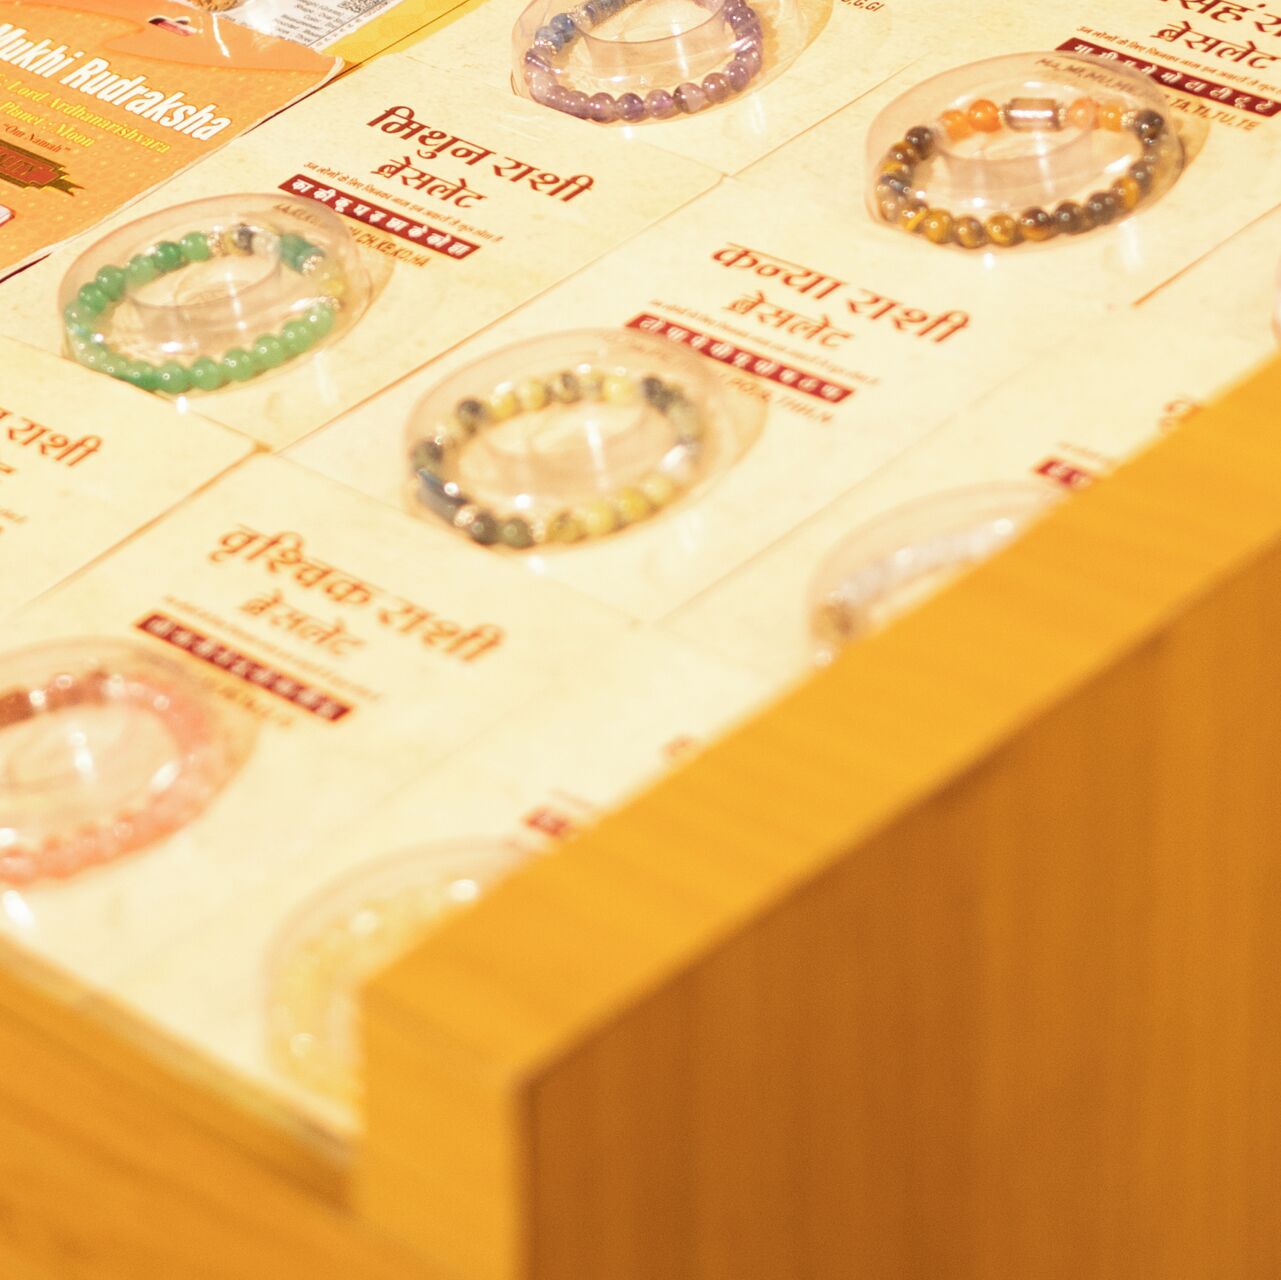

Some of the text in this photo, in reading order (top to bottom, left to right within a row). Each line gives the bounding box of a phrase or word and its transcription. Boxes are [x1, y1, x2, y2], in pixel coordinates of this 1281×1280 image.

[1150, 20, 1281, 70] ब्रेसलेट
[7, 80, 50, 103] Lord
[48, 95, 172, 155] Ardhanarishvara
[64, 57, 233, 141] Rudraksha
[54, 124, 95, 148] Moon
[366, 105, 496, 166] मिथुन
[492, 156, 595, 202] राशी
[370, 155, 488, 209] ब्रेसलेट
[711, 242, 847, 300] कन्या
[846, 288, 970, 343] राशी
[723, 290, 854, 349] ब्रेसलेट
[6, 417, 103, 467] राशी
[377, 596, 505, 663] राशी
